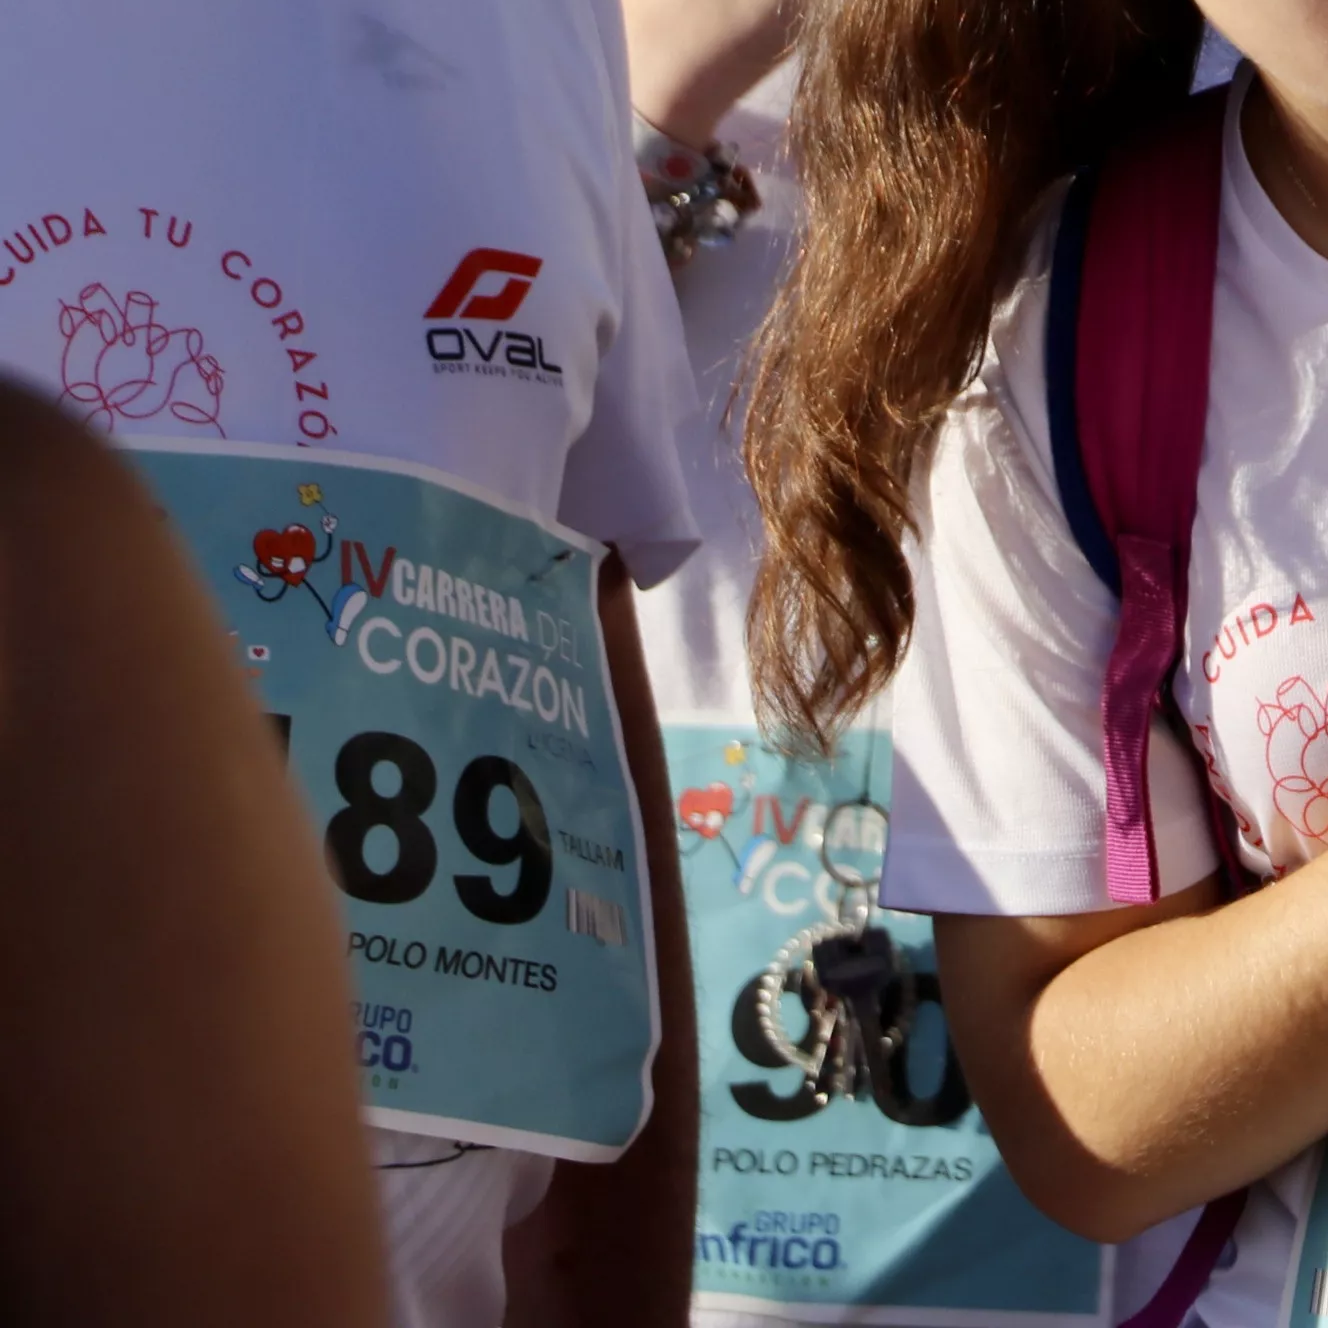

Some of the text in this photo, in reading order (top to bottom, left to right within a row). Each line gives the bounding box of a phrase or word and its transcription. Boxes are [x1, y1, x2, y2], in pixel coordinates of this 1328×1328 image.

[138, 207, 192, 248] TU
[221, 250, 338, 448] CORAZÓ
[340, 540, 584, 669] IV CARRERA DEL
[1200, 592, 1315, 685] CUIDA
[358, 616, 590, 740] CORAZÓN
[265, 714, 553, 926] 89
[346, 931, 559, 993] POLO MONTES
[713, 1146, 974, 1183] POLO PEDRAZAS
[697, 1221, 839, 1271] nfrico
[755, 1210, 841, 1236] GRUPO
